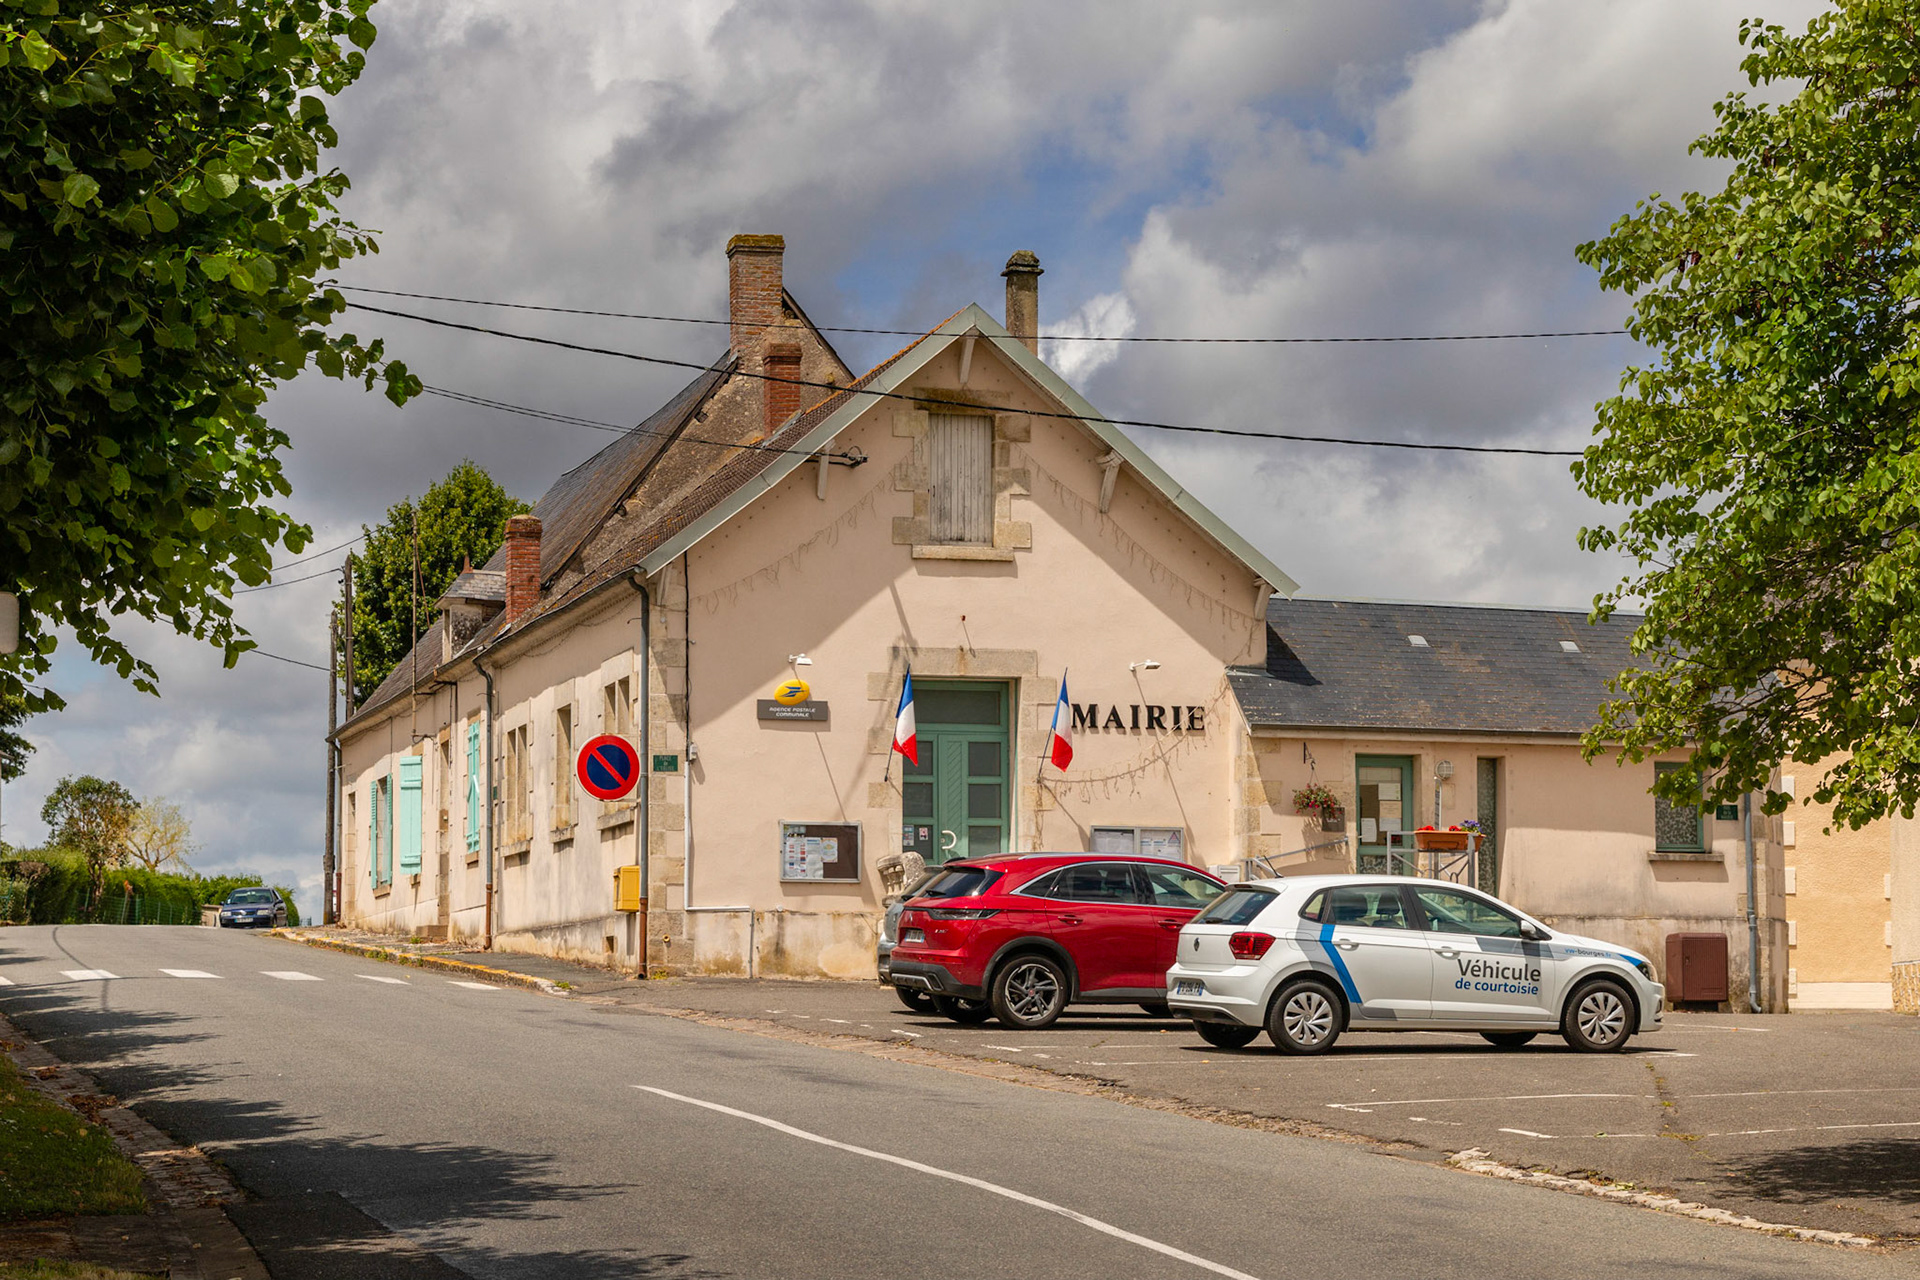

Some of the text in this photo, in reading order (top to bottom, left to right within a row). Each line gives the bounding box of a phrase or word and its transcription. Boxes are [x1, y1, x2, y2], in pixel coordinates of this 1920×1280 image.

[1071, 703, 1205, 731] MAIRIE
[1565, 948, 1611, 958] vw-bourges.fr
[1457, 959, 1541, 982] Véhicule
[1455, 978, 1539, 995] de courtoisie
